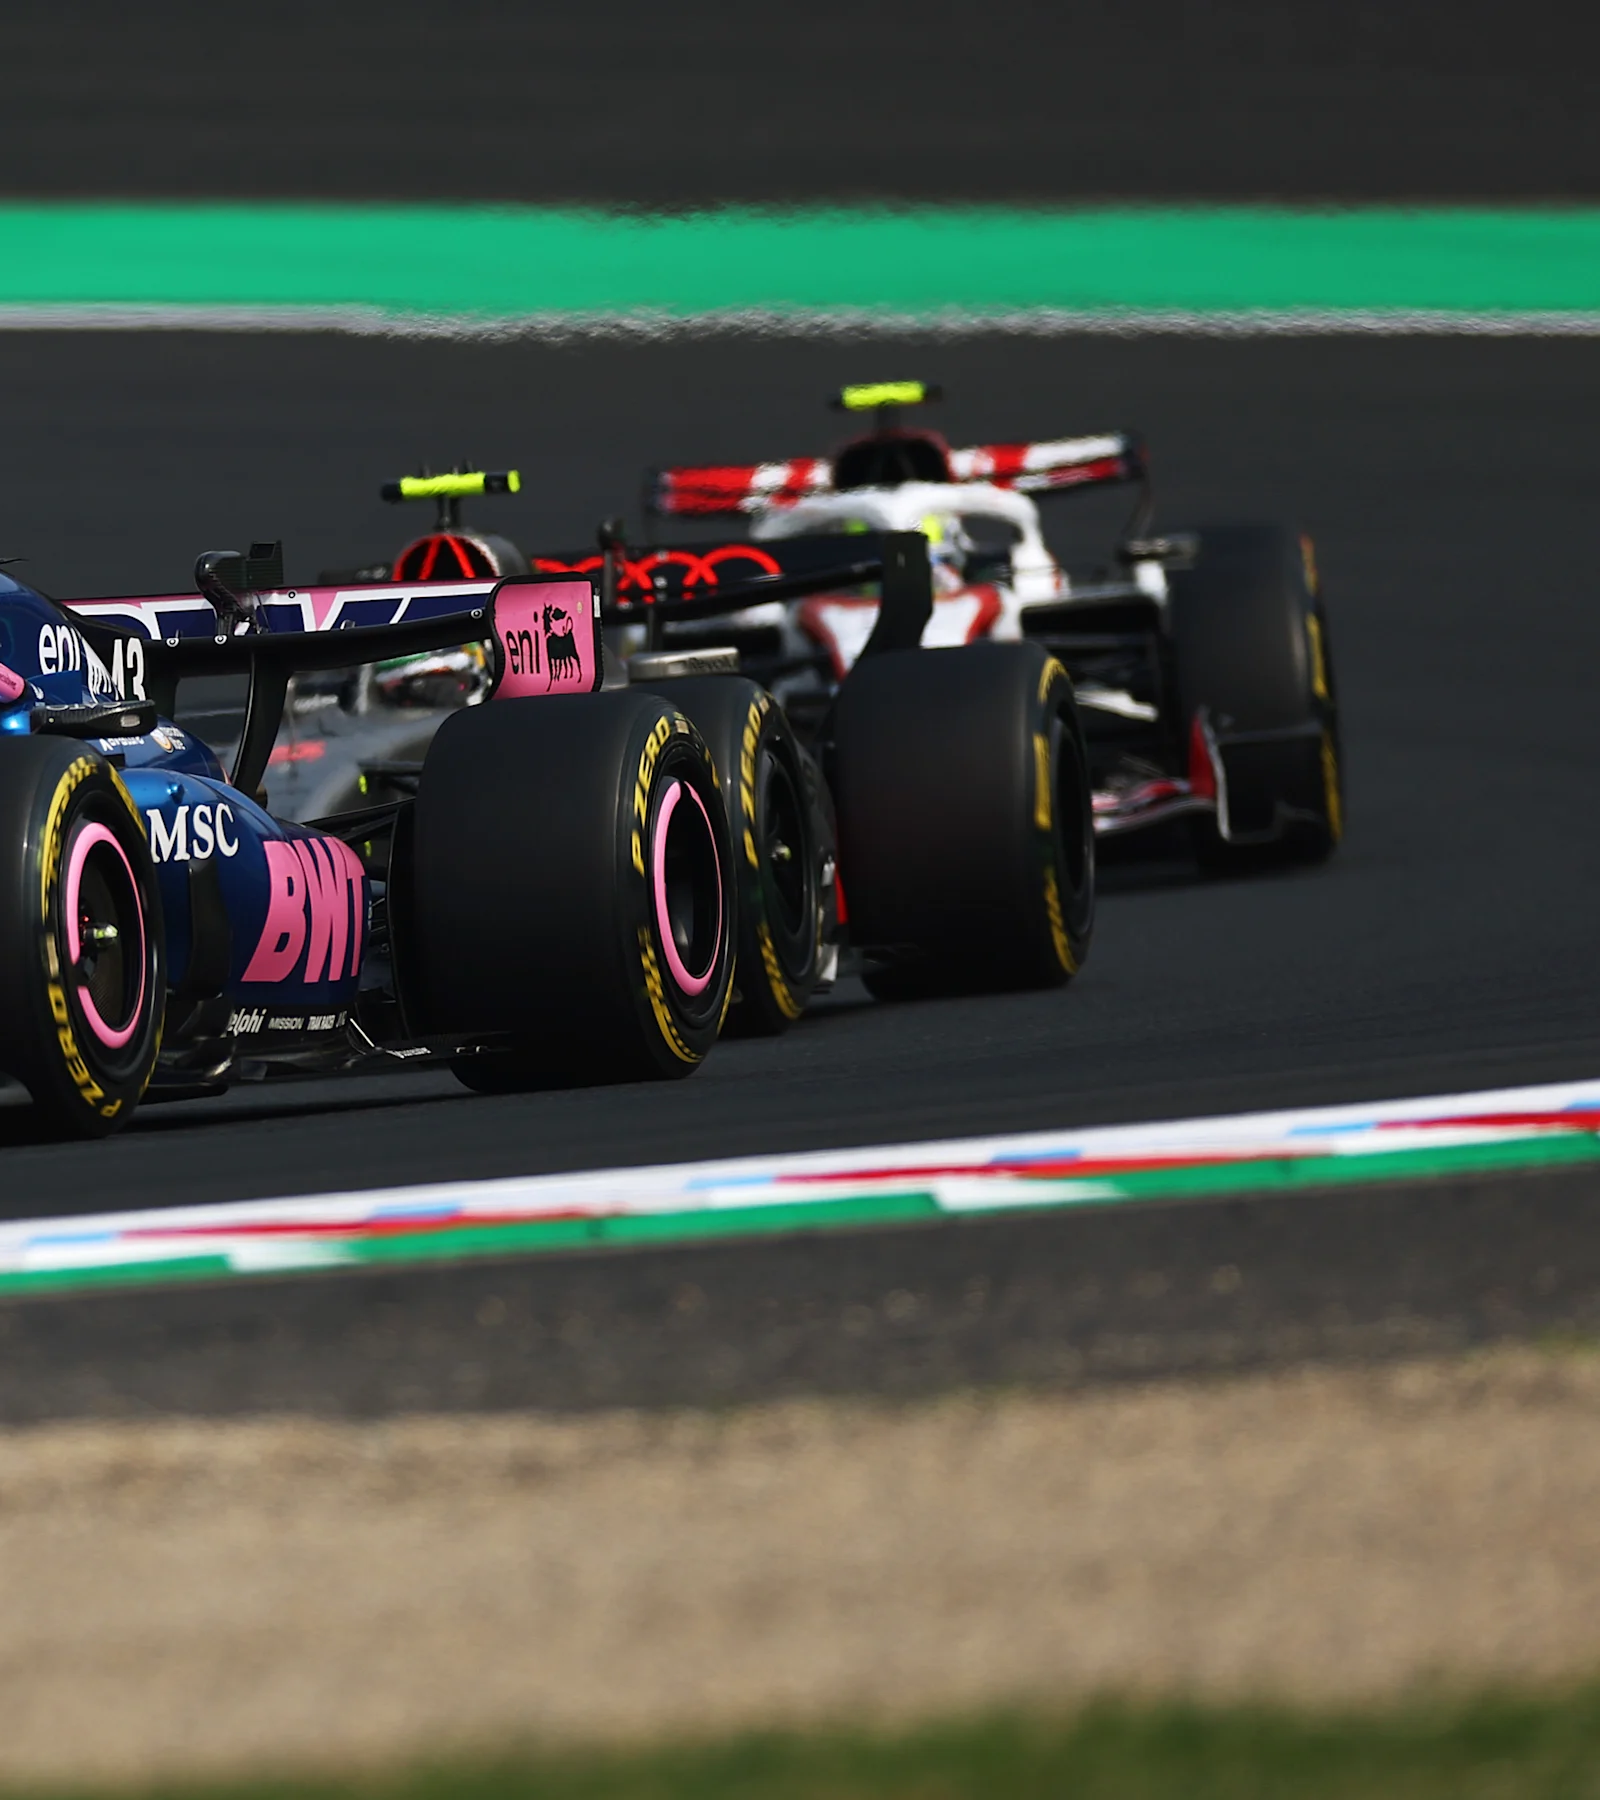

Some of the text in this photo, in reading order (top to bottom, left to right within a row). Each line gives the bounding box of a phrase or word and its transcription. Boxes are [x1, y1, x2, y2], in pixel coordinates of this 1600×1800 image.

[38, 623, 81, 675] eni
[111, 637, 146, 701] 43
[505, 611, 542, 675] eni
[740, 702, 762, 823] ZERO
[631, 716, 671, 877] P ZERO
[145, 803, 239, 863] MSC
[240, 836, 366, 984] BWT
[48, 983, 105, 1107] ZERO
[267, 1016, 305, 1031] MISSION
